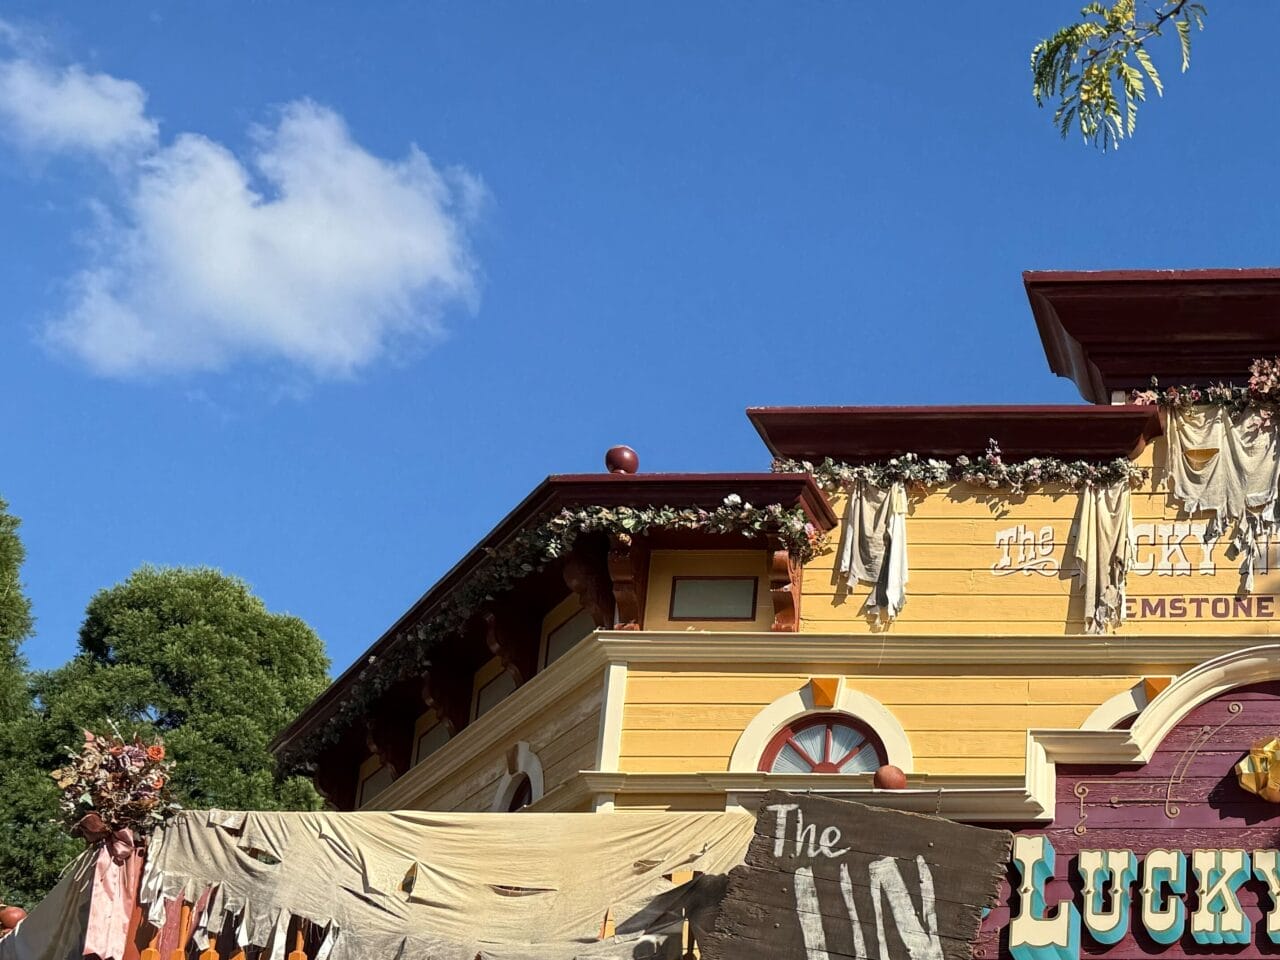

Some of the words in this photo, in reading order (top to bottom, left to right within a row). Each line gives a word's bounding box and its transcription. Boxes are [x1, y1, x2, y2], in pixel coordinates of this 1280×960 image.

[993, 524, 1057, 571] The
[1131, 523, 1217, 576] CKY
[1126, 596, 1274, 619] EMSTONE
[766, 803, 851, 858] The
